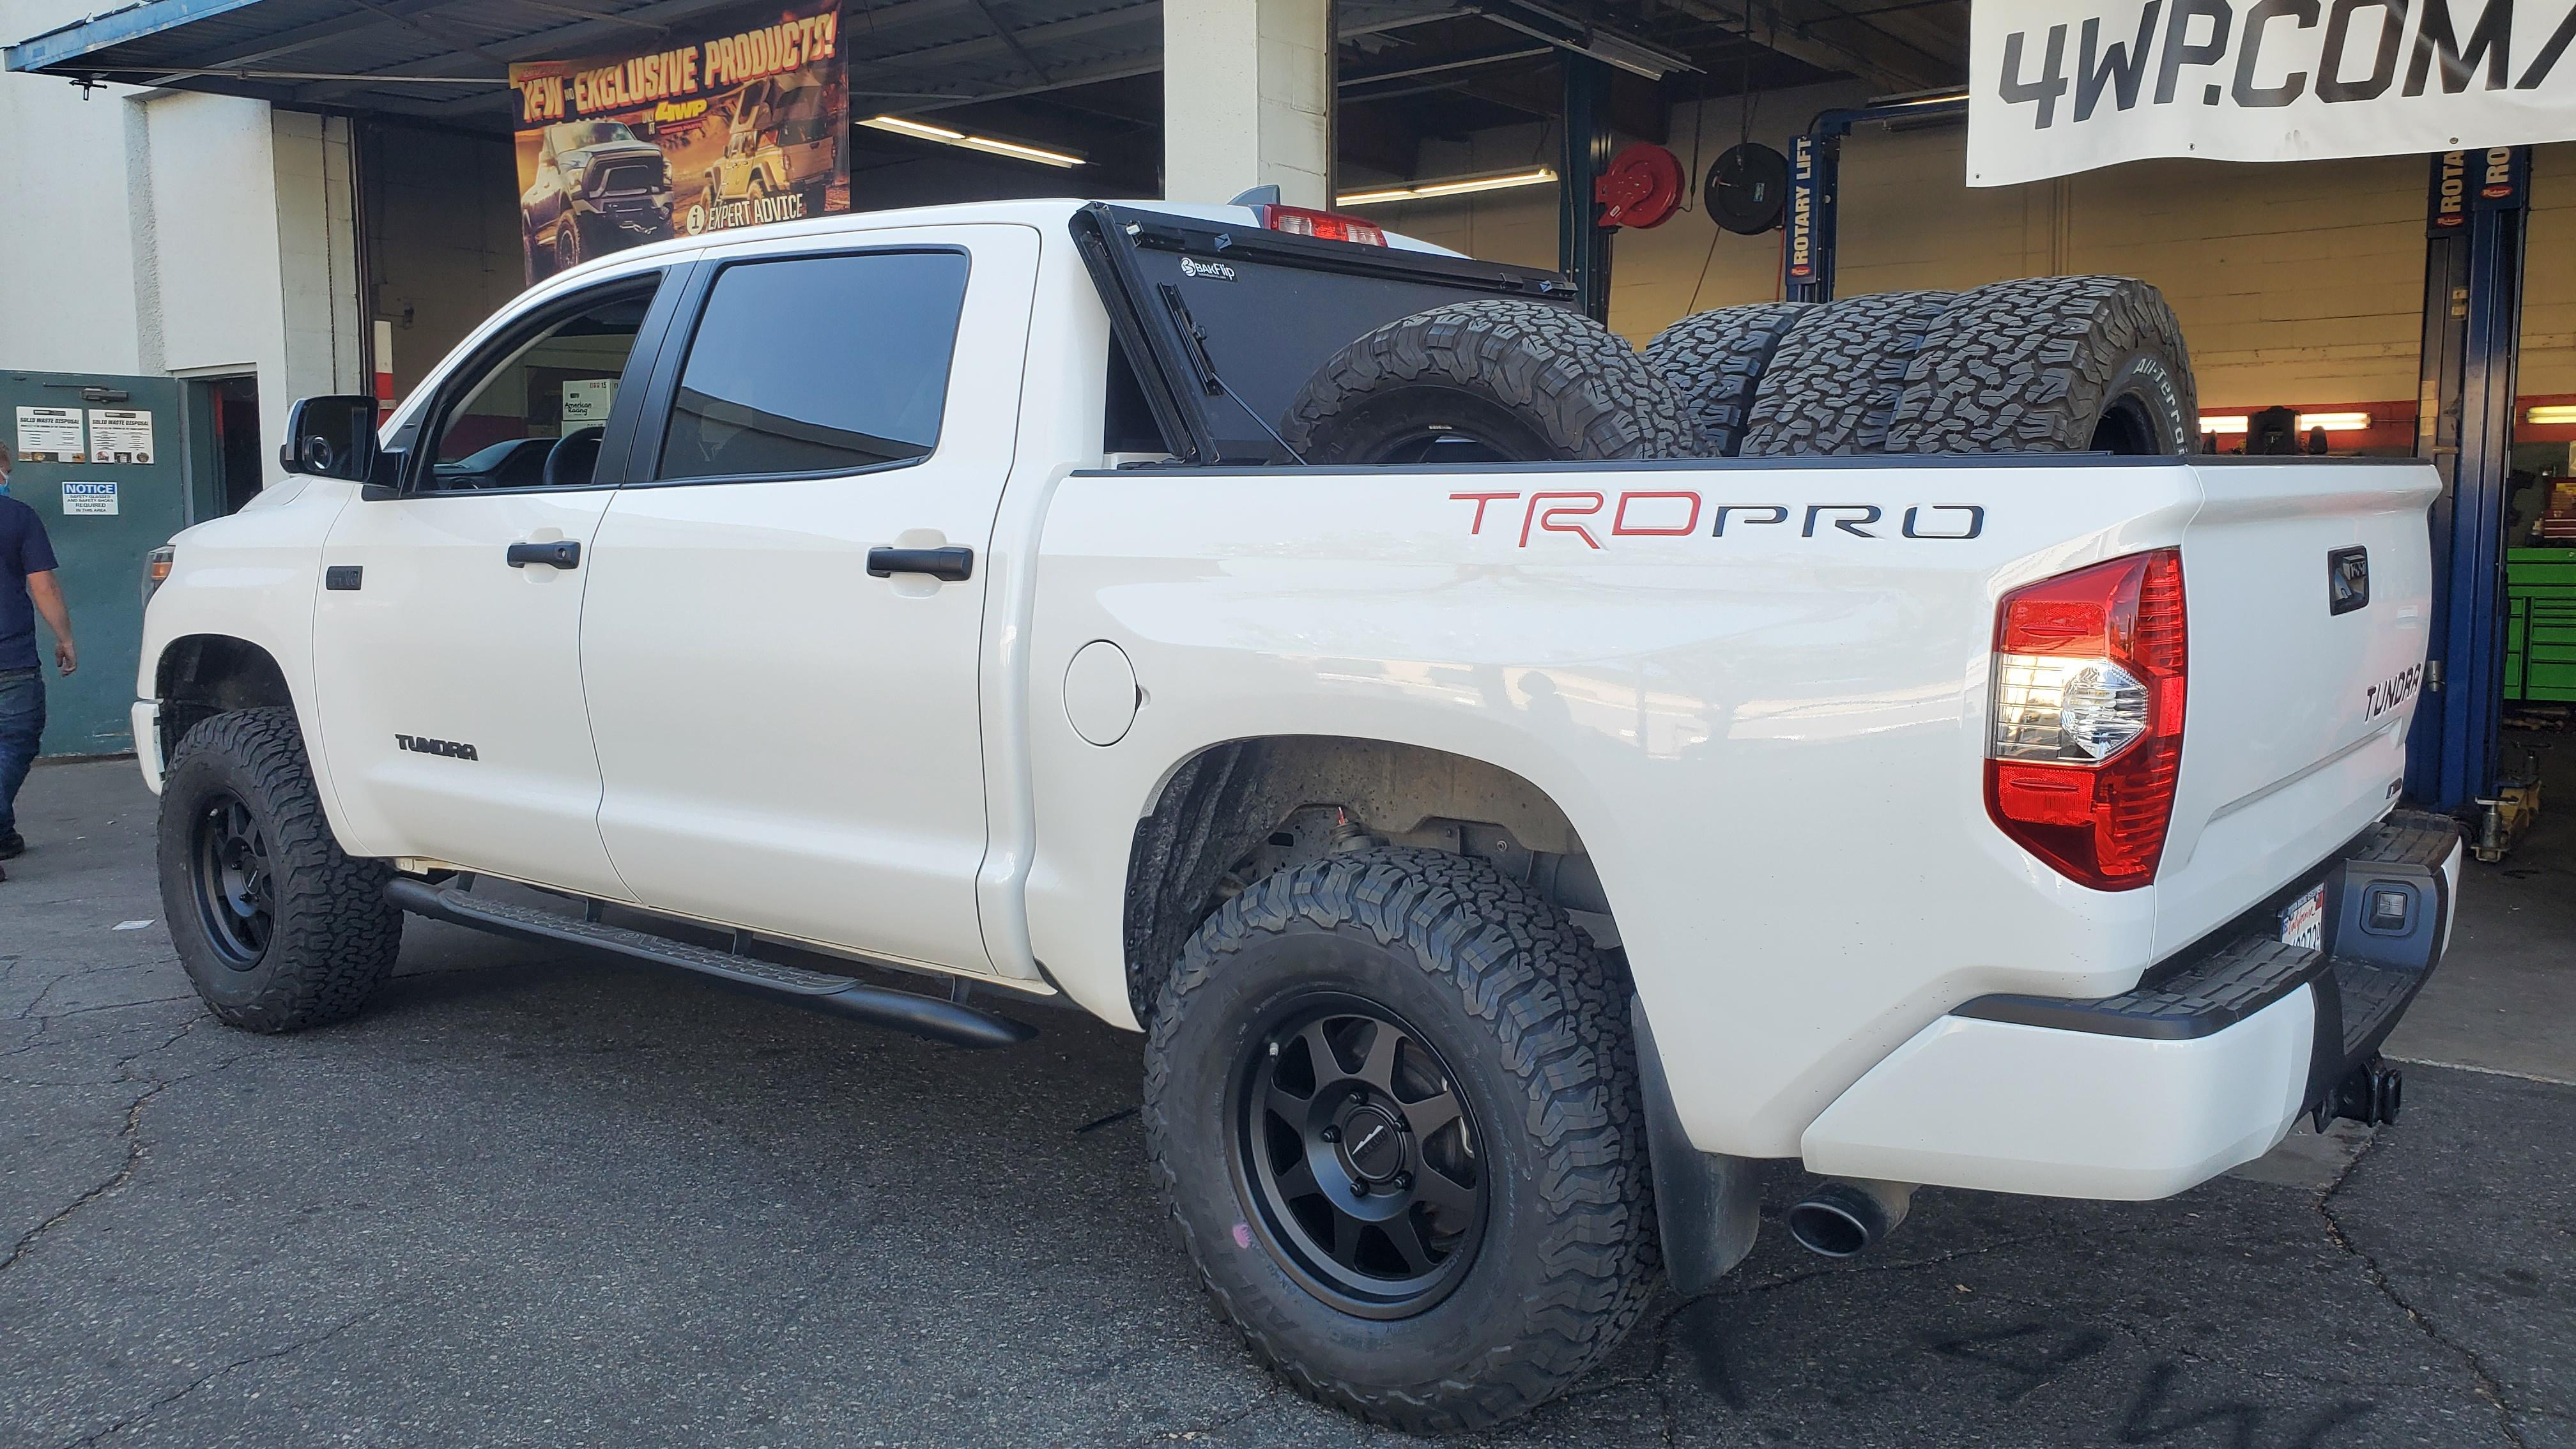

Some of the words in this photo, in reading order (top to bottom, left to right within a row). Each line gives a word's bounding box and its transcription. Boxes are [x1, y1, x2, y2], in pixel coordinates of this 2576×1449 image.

[574, 46, 698, 114] EXCLUSIVE
[705, 11, 837, 88] PRODUCTS!
[655, 99, 707, 122] 4WP
[1797, 139, 1812, 180] LIFT
[709, 201, 750, 231] EXPERT
[755, 194, 803, 224] ADVICE
[1793, 186, 1810, 265] ROTARY
[65, 484, 114, 493] NOTICE
[1449, 491, 1701, 549] TRD
[1712, 505, 1985, 539] PRO
[2365, 663, 2421, 723] TUNDRA
[394, 733, 479, 761] TUNDRA
